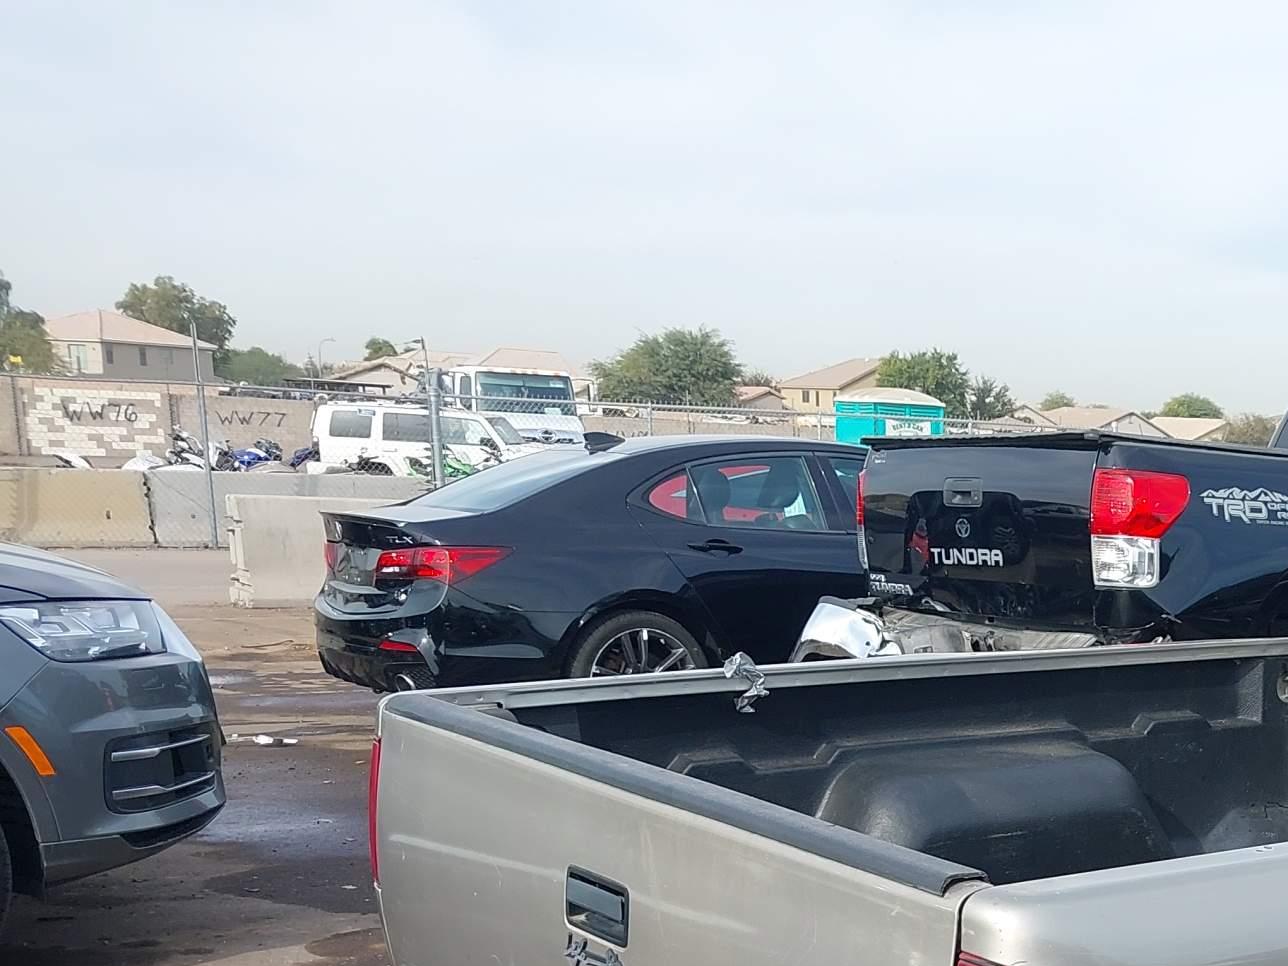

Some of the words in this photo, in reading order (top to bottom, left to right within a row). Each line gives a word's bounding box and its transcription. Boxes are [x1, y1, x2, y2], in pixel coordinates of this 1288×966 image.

[61, 400, 138, 422] WW76
[215, 410, 287, 427] WW77
[1203, 498, 1268, 524] TRD
[385, 536, 414, 544] TLX
[930, 548, 1003, 566] TUNDRA
